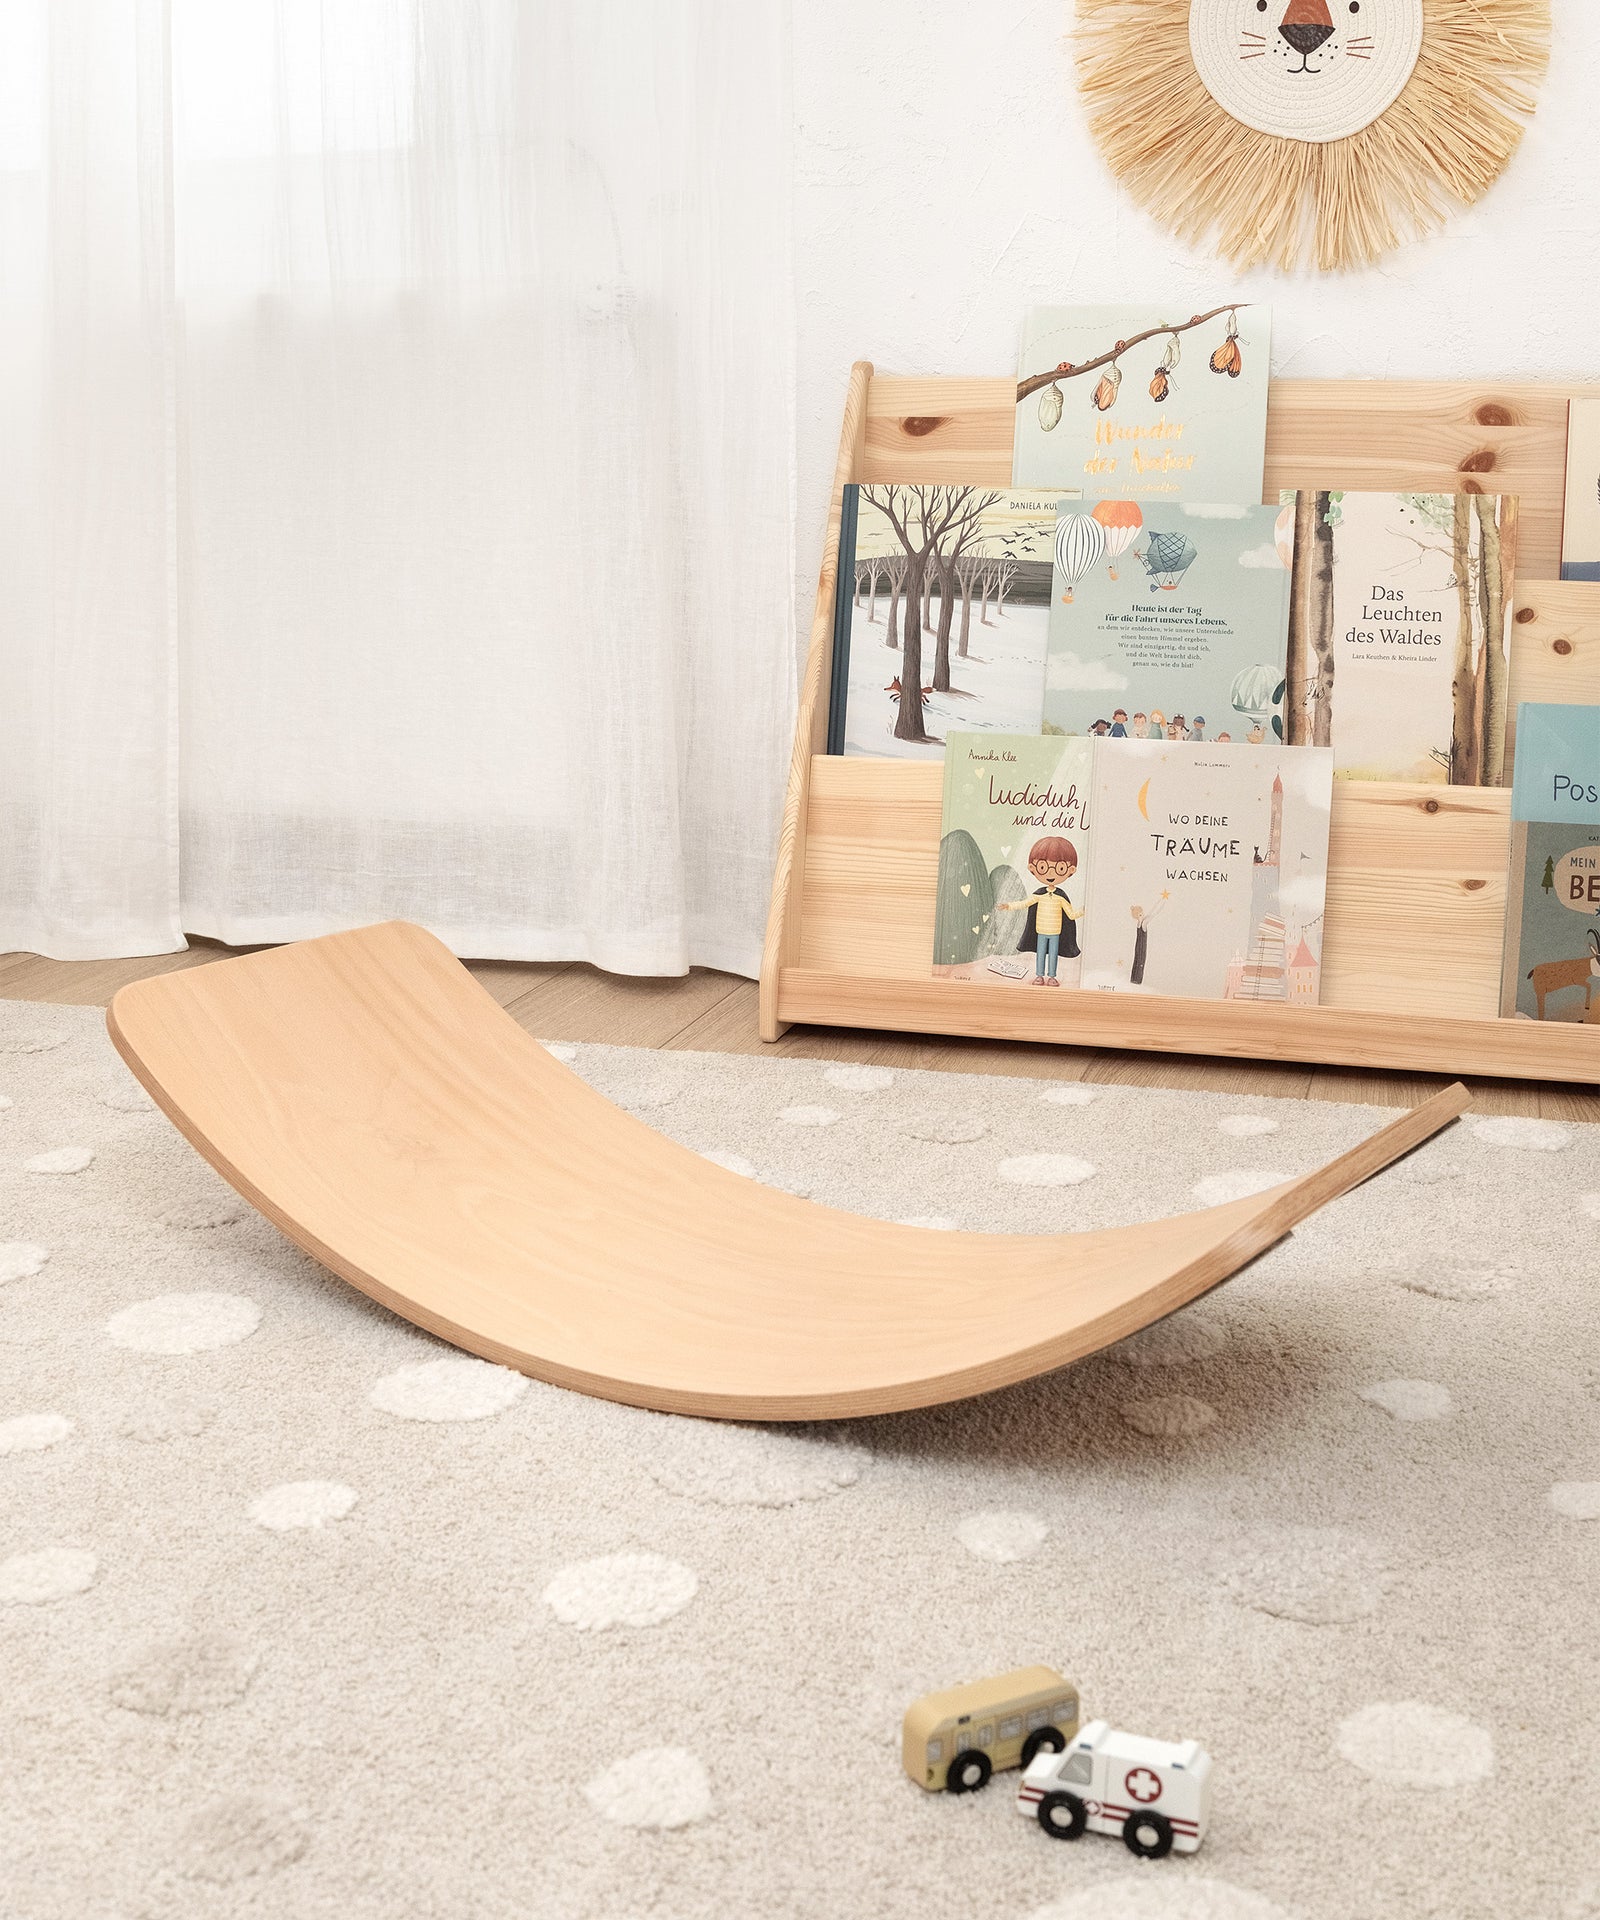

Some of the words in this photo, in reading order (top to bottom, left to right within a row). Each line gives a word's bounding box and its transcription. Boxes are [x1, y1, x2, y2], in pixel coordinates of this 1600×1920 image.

[1095, 413, 1184, 445] Wunder
[1084, 449, 1117, 475] der
[1131, 448, 1194, 474] Natur
[1010, 501, 1041, 510] DANIELA
[1043, 502, 1058, 511] KUL
[1371, 585, 1404, 601] Das
[1132, 604, 1156, 612] Heute
[1186, 606, 1202, 616] Tag
[1362, 605, 1443, 622] Leuchten
[1105, 613, 1119, 621] für
[1120, 614, 1133, 622] die
[1135, 615, 1158, 623] Fahrt
[1195, 618, 1227, 626] Lebens,
[1345, 627, 1374, 643] des
[1379, 628, 1442, 646] Waldes
[1144, 643, 1177, 651] einzigartig,
[1398, 654, 1418, 662] Kheira
[968, 748, 1000, 761] Annika
[1001, 750, 1017, 762] Klee
[989, 775, 1080, 810] Ludiduh
[1553, 774, 1598, 803] Pos
[1012, 810, 1047, 827] und
[1051, 811, 1075, 829] die
[1079, 801, 1091, 831] L
[1168, 813, 1190, 825] WO
[1195, 815, 1228, 827] DEINE
[1150, 834, 1240, 859] TRÄUME
[1570, 857, 1597, 868] MEIN
[1166, 868, 1229, 882] WACHSEN
[1570, 874, 1600, 902] BE
